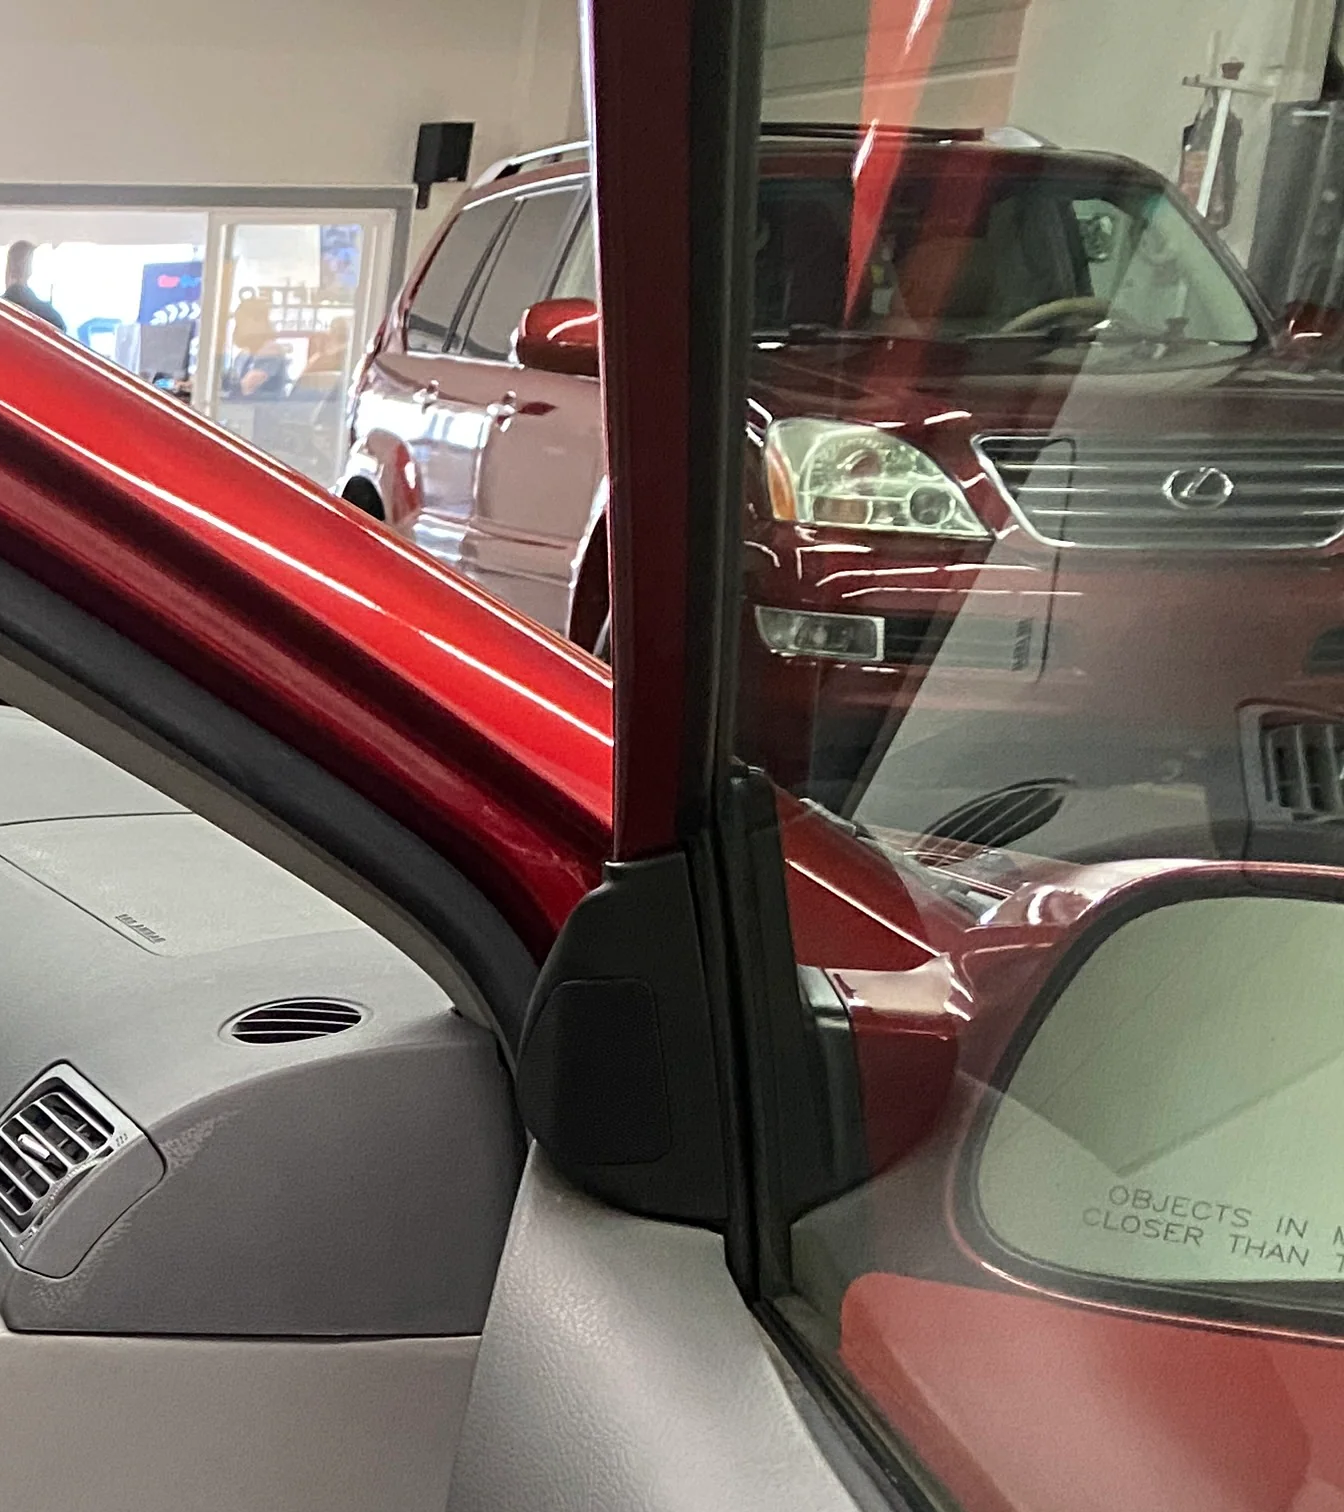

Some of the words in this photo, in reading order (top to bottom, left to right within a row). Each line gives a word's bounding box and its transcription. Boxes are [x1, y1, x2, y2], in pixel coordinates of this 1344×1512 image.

[1082, 1207, 1204, 1246] CLOSER
[1229, 1233, 1309, 1267] THAN
[1108, 1185, 1252, 1228] OBJECTS
[1276, 1216, 1308, 1239] IN
